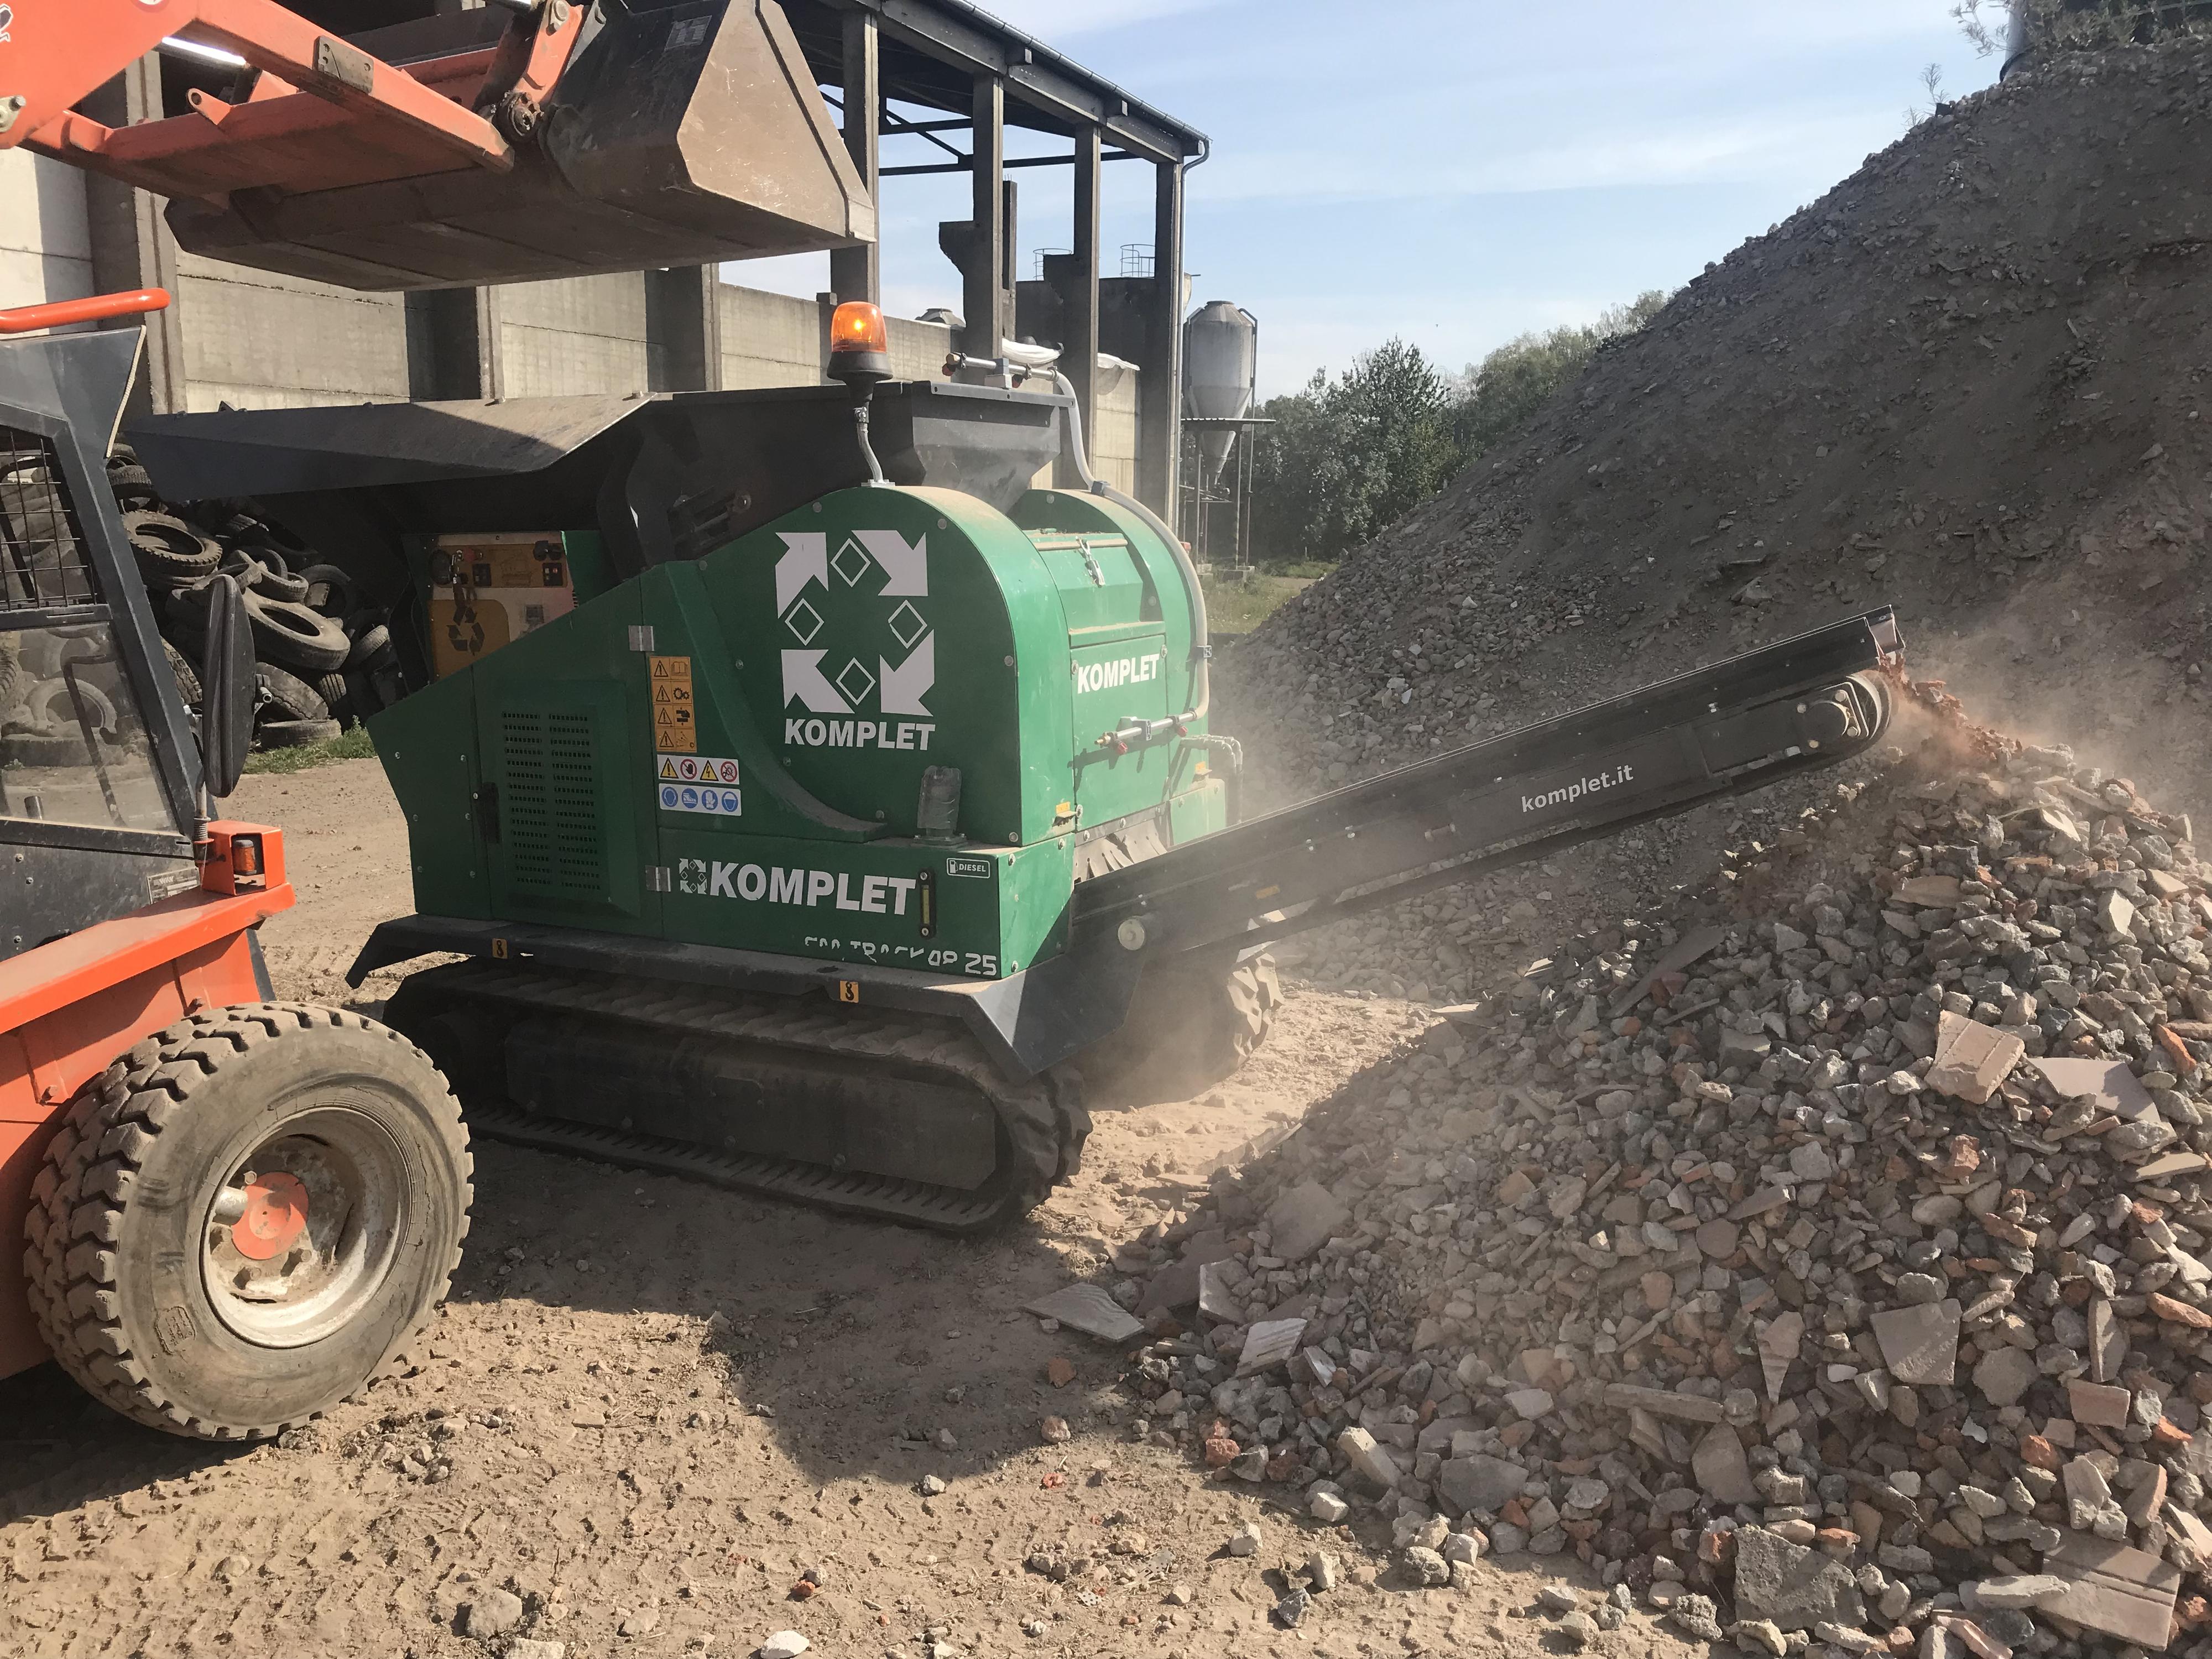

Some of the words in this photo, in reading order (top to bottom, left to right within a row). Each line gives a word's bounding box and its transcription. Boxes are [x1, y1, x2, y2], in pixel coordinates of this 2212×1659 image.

[1077, 653, 1160, 695] KOMPLET
[784, 718, 936, 751] KOMPLET
[1521, 764, 1634, 812] komplet.it
[959, 863, 986, 872] DIESEL
[709, 860, 916, 916] KOMPLET
[965, 952, 997, 976] 25
